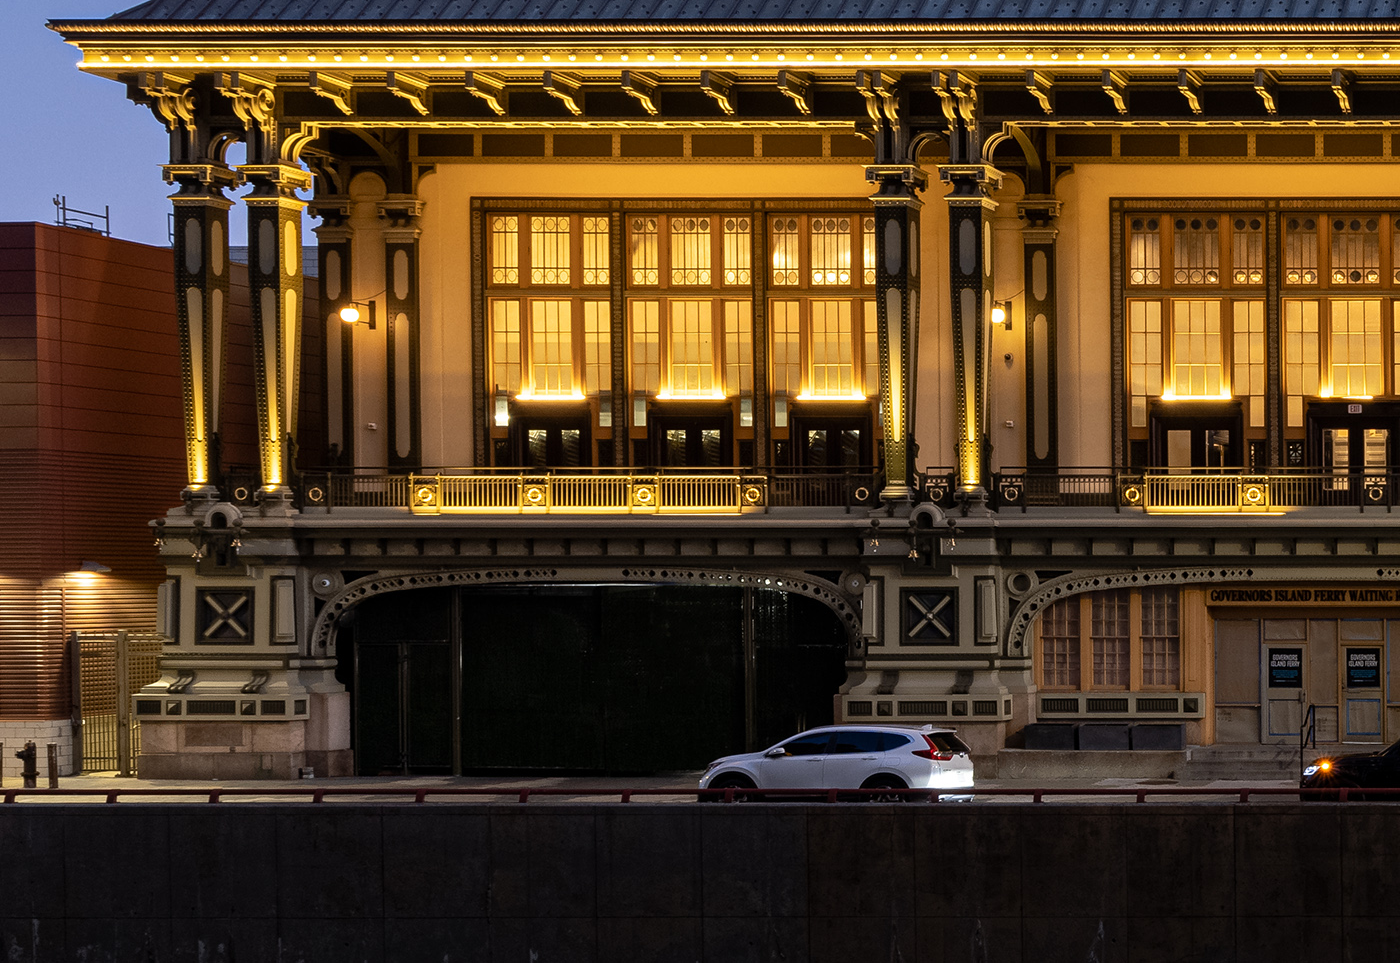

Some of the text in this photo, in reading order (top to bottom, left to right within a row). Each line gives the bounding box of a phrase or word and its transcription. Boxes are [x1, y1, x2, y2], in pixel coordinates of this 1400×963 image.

[1210, 589, 1273, 602] GOVERNORS
[1274, 589, 1312, 602] ISLAND
[1313, 589, 1347, 602] FERRY
[1348, 589, 1393, 602] WAITING
